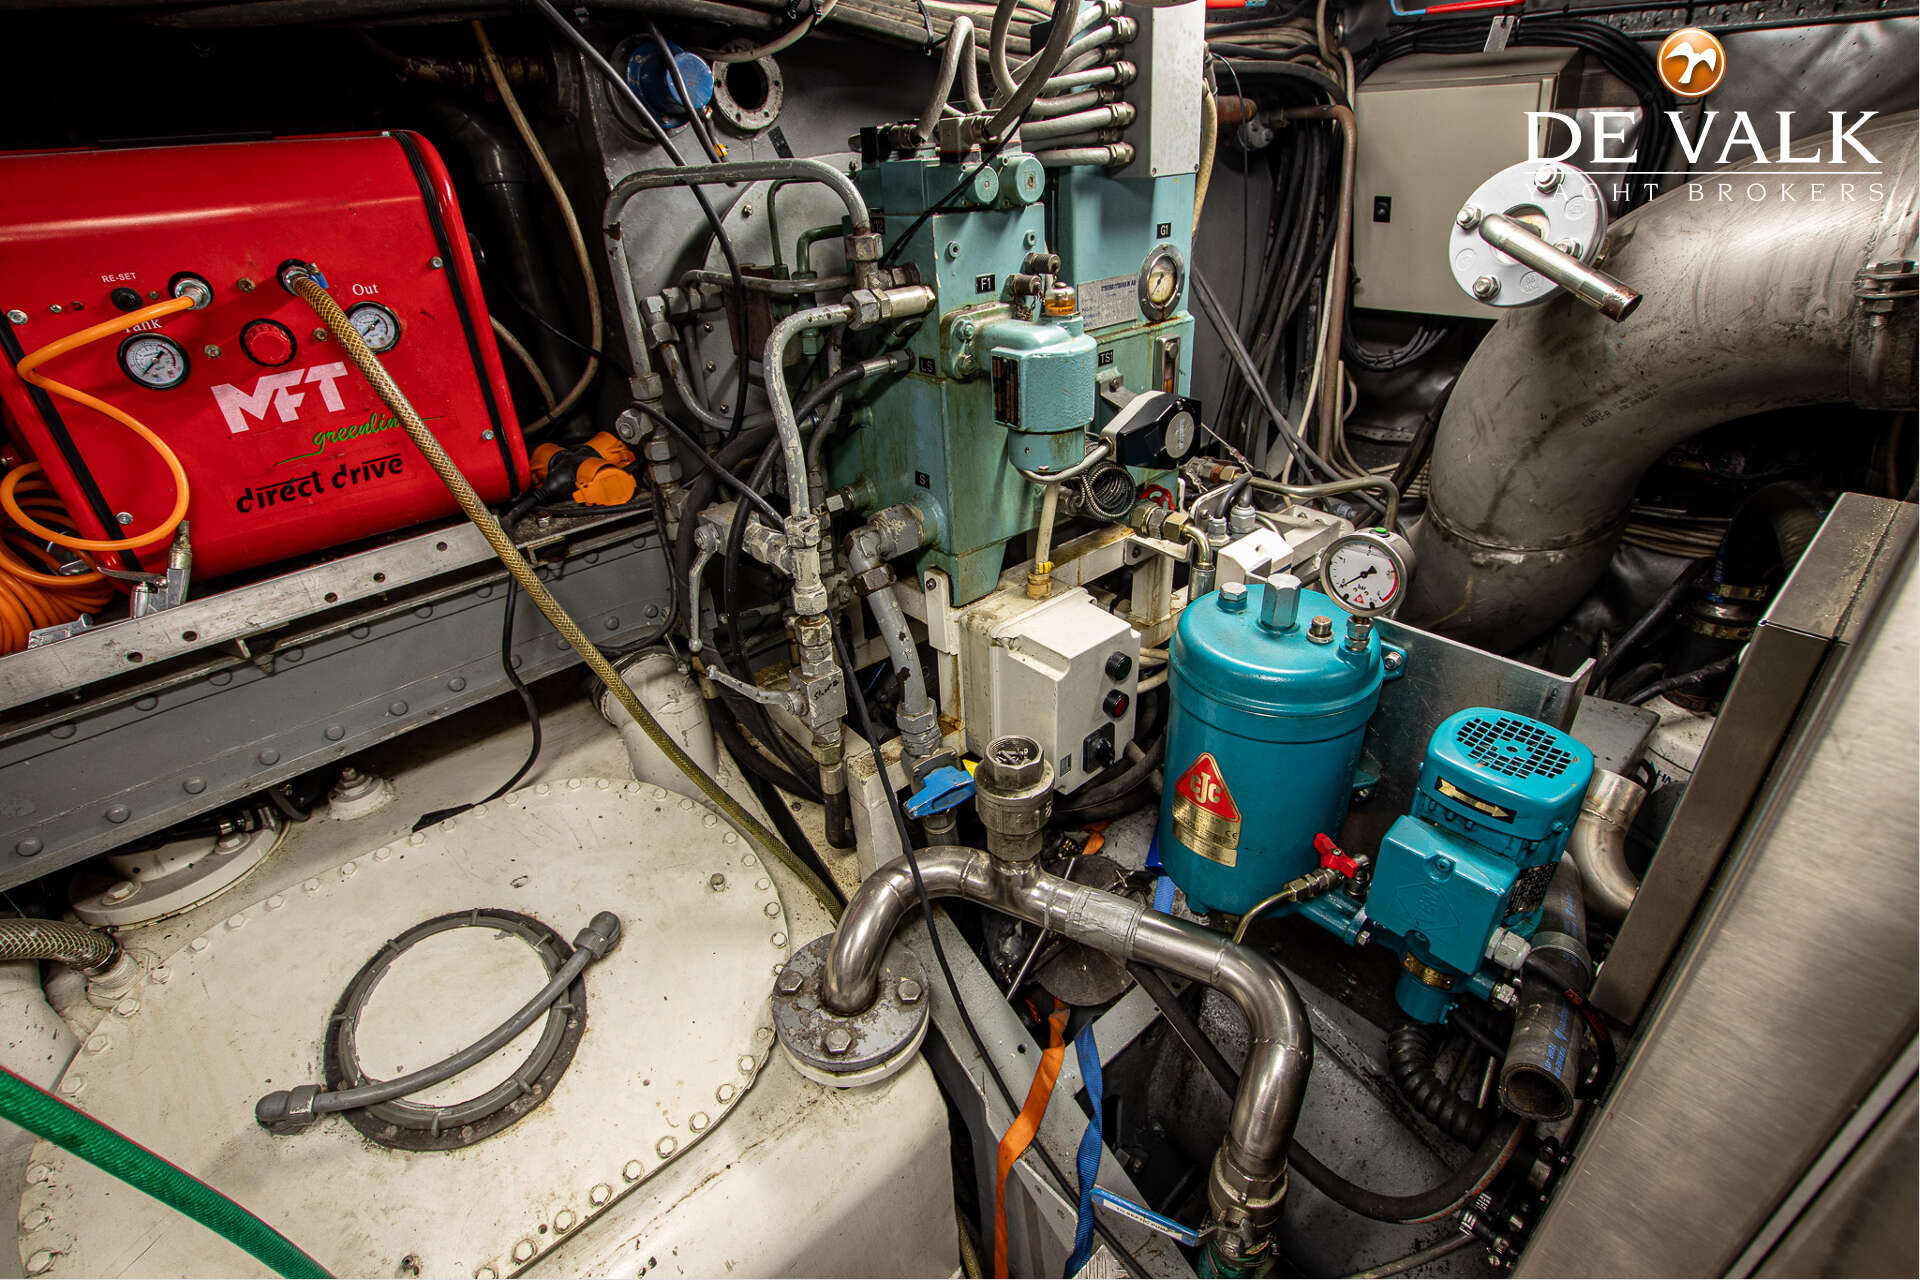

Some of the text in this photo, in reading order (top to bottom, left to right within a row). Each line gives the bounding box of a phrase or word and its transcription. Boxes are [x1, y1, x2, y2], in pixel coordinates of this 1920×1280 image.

[1160, 225, 1169, 236] G1
[101, 272, 137, 283] RE-SET
[981, 277, 991, 291] F1
[352, 283, 379, 296] Out
[125, 319, 163, 333] ank
[920, 359, 934, 373] LS
[210, 361, 348, 434] MFT
[312, 412, 402, 455] greenlin
[236, 453, 403, 513] direct drive
[919, 473, 926, 486] S
